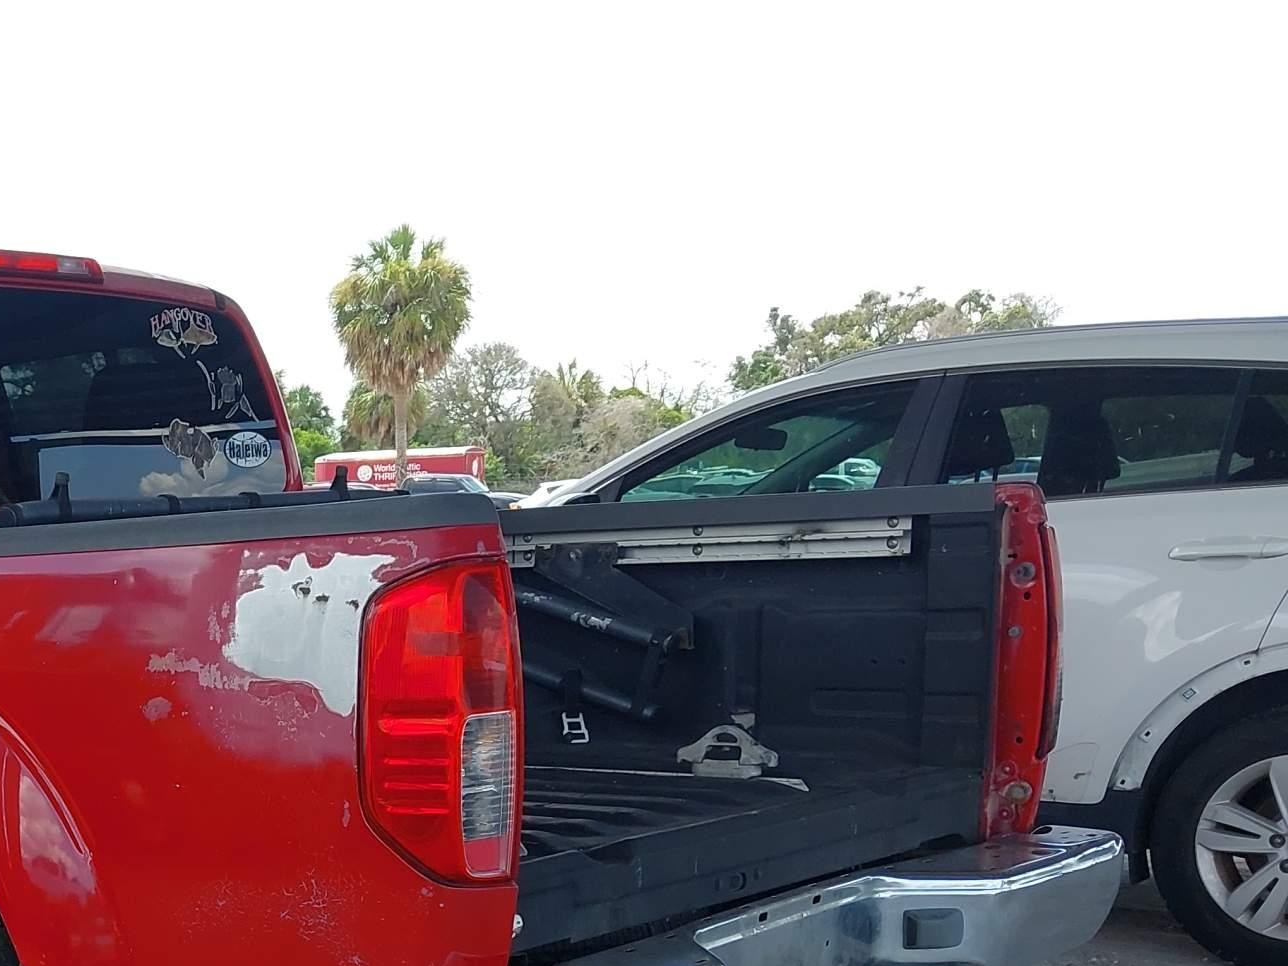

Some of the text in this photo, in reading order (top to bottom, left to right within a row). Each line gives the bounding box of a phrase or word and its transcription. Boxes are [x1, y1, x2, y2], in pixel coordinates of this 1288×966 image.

[150, 307, 216, 338] HANGOVER
[228, 440, 268, 459] Haleiwa
[373, 463, 396, 472] World
